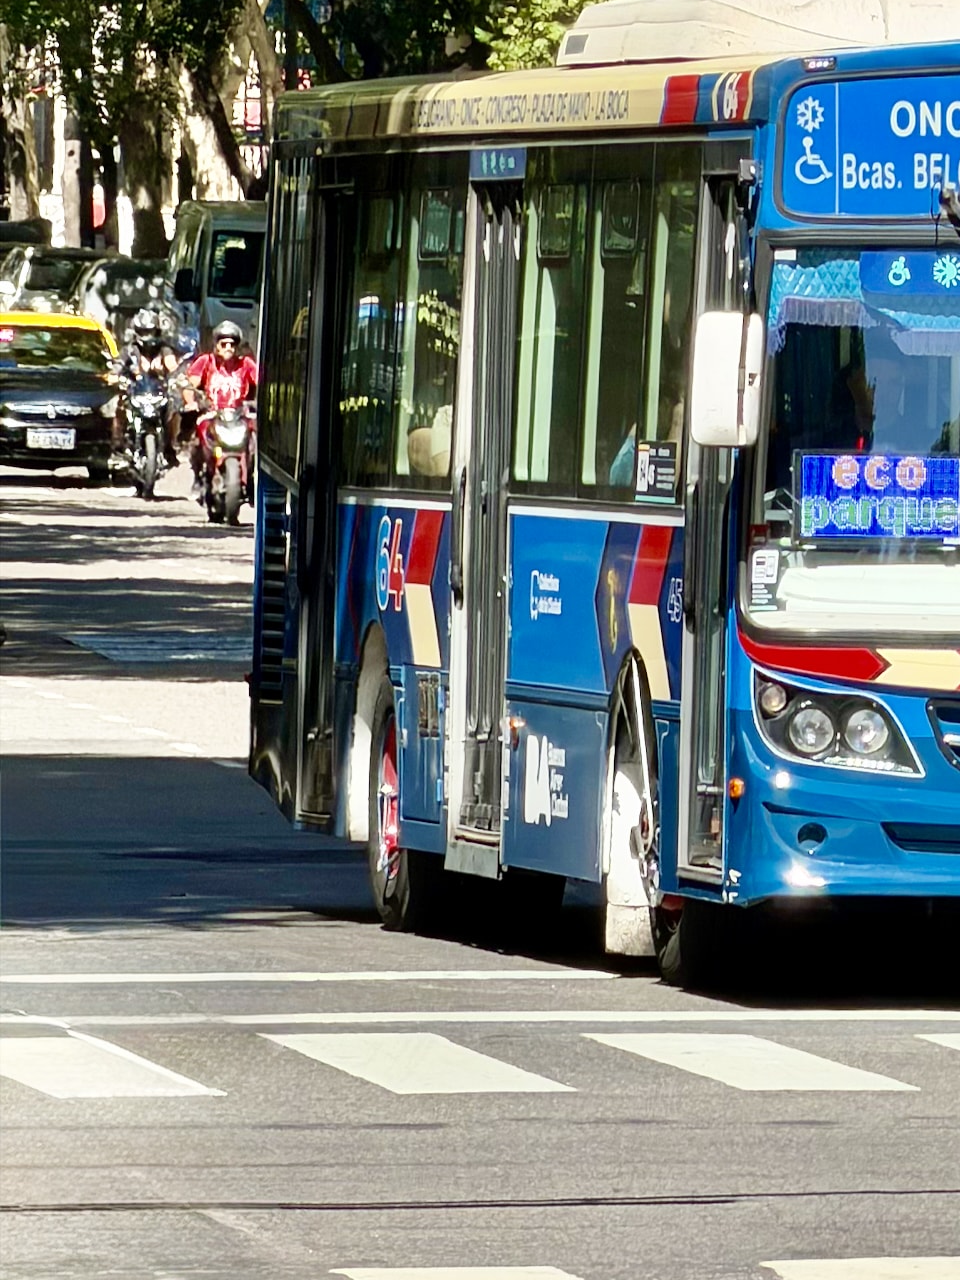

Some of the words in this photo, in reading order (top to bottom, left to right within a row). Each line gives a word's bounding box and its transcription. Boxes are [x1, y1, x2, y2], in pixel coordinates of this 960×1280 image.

[461, 96, 482, 125] ONCE
[486, 94, 527, 124] CONGRESO
[532, 93, 555, 122] PLAZA
[556, 92, 568, 121] DE
[568, 92, 590, 120] MAYO
[595, 90, 606, 120] LA
[606, 90, 629, 119] BOCA
[842, 153, 903, 189] Bcas.
[832, 455, 927, 490] eco
[801, 495, 959, 537] parque
[376, 515, 404, 611] 64
